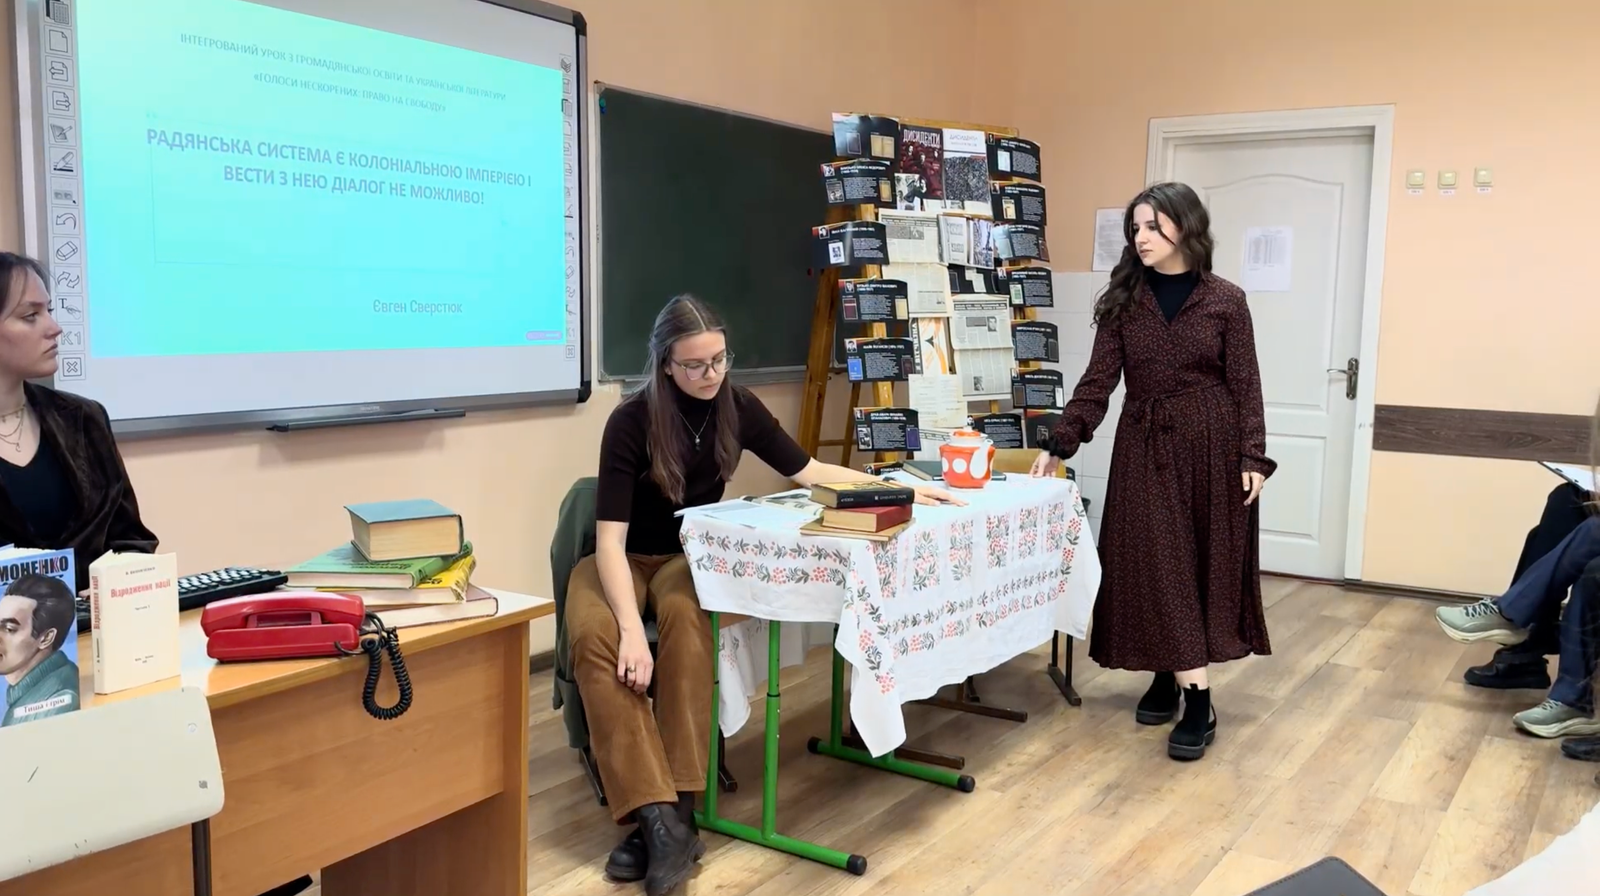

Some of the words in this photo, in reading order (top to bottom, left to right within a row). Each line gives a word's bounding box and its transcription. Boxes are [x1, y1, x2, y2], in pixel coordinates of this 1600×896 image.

[180, 33, 259, 56] ІНТЕГРОВАНИЙ
[260, 47, 287, 61] УРОК
[296, 54, 371, 76] ГРОМАДЯНСЬКОЇ
[373, 68, 403, 83] ОСВІТИ
[405, 74, 415, 84] ТА
[415, 77, 464, 93] УКРАЇНСЬКОЇ
[465, 87, 507, 101] ЛІТЕРАТУРИ
[253, 72, 298, 88] «ГОЛОСИ
[300, 78, 360, 98] НЕСКОРЕНИХ:
[362, 90, 391, 103] ПРАВО
[392, 95, 404, 105] НА
[405, 96, 446, 113] СВОБОДУ»
[903, 128, 941, 146] ДИСИДЕНТИ
[146, 128, 253, 156] РАДЯНСЬКА
[257, 141, 332, 165] СИСТЕМА
[335, 151, 345, 166] Є
[349, 152, 463, 179] КОЛОНІАЛЬНОЮ
[465, 167, 526, 188] ІМПЕРІЄЮ
[223, 165, 275, 185] ВЕСТИ
[278, 170, 288, 186] З
[292, 172, 328, 190] НЕЮ
[331, 175, 386, 195] ДІАЛОГ
[389, 182, 406, 197] НЕ
[410, 184, 485, 205] МОЖЛИВО!
[373, 299, 407, 313] Євген
[410, 299, 463, 316] Сверстюк
[110, 583, 153, 599] Відродження
[155, 578, 171, 590] нації
[24, 702, 44, 713] Тиша
[50, 697, 66, 709] грім
